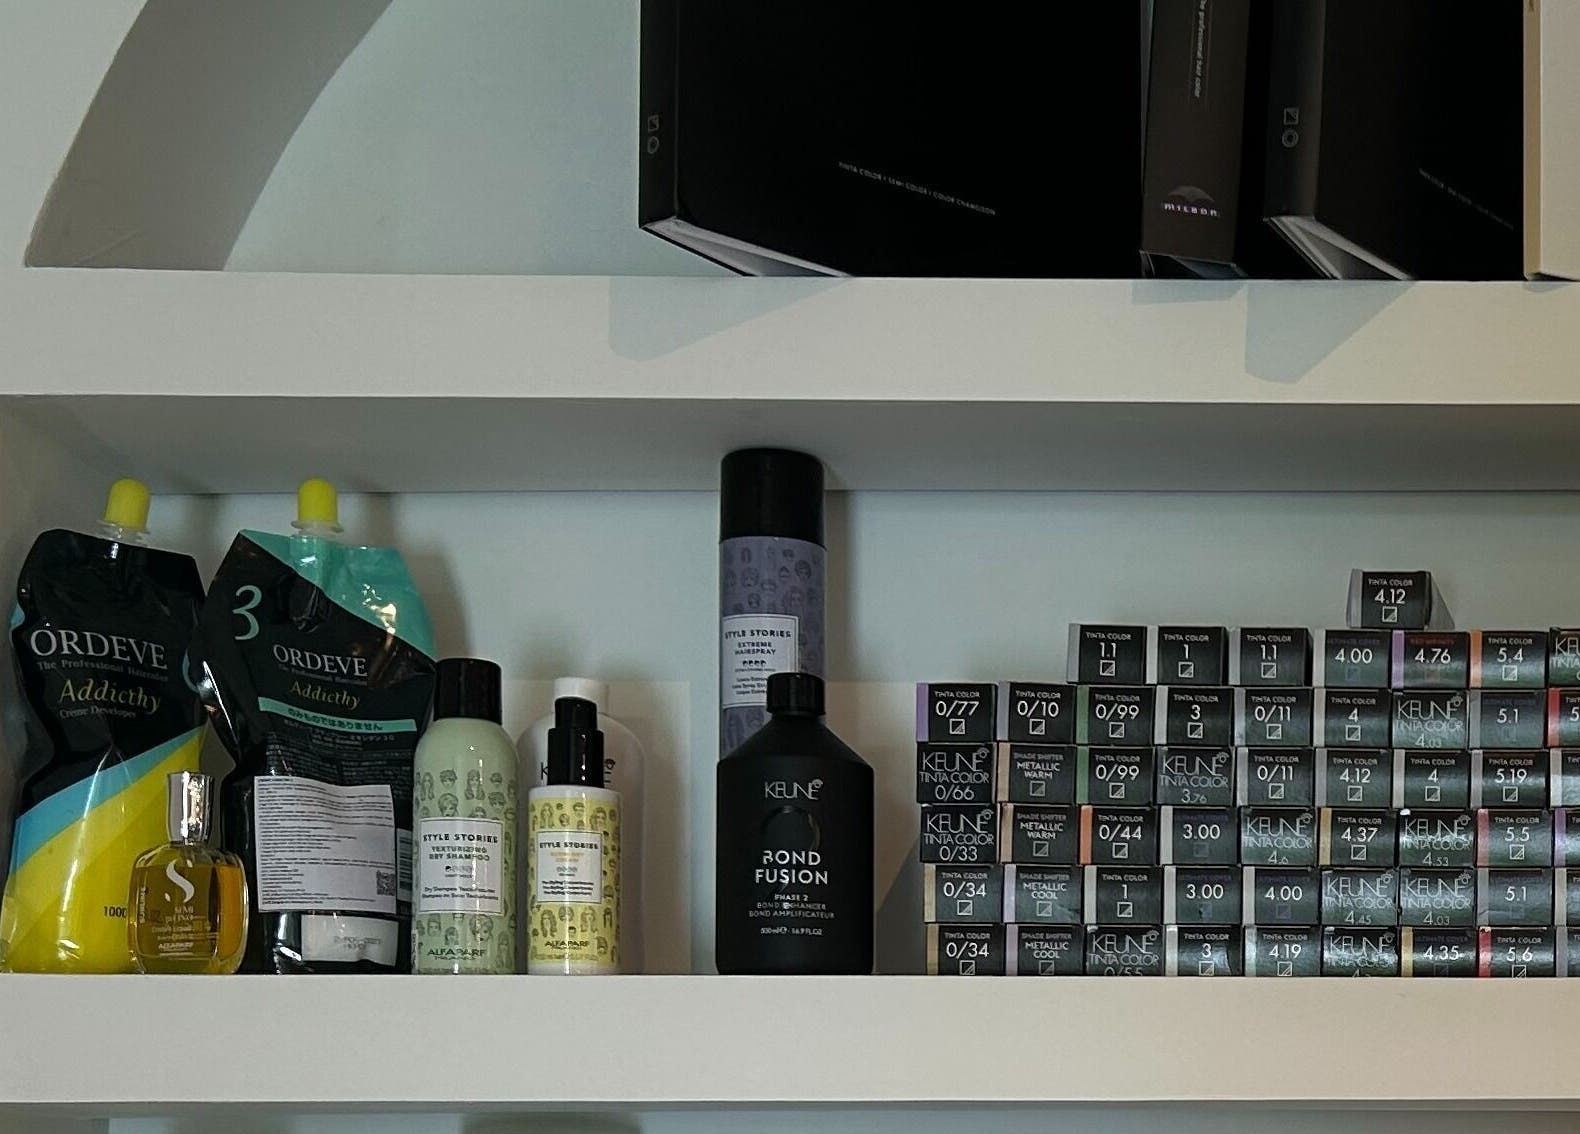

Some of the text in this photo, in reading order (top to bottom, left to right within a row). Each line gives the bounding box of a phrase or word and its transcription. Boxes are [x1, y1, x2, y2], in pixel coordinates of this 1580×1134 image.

[1374, 589, 1406, 605] 4.12
[233, 585, 263, 640] 3
[30, 629, 168, 671] ORDEVE
[1101, 642, 1117, 658] 1.1
[1414, 649, 1451, 664] 4.76
[273, 644, 368, 677] ORDEVE
[58, 678, 161, 714] Addicthy
[289, 680, 361, 710] Addicthy
[936, 701, 979, 717] 0/77
[1096, 705, 1139, 720] 0/99
[1017, 762, 1060, 772] METALLIC
[1024, 770, 1053, 780] WARM
[920, 772, 989, 785] TINTA COLOR
[764, 779, 823, 800] KEUNE
[935, 785, 974, 801] 0/66
[423, 834, 498, 843] STYLE STORIES
[1099, 825, 1142, 841] 0/44
[1341, 827, 1378, 843] 4.37
[763, 850, 821, 865] BOND
[755, 869, 828, 884] FUSION
[946, 942, 989, 958] 0/34
